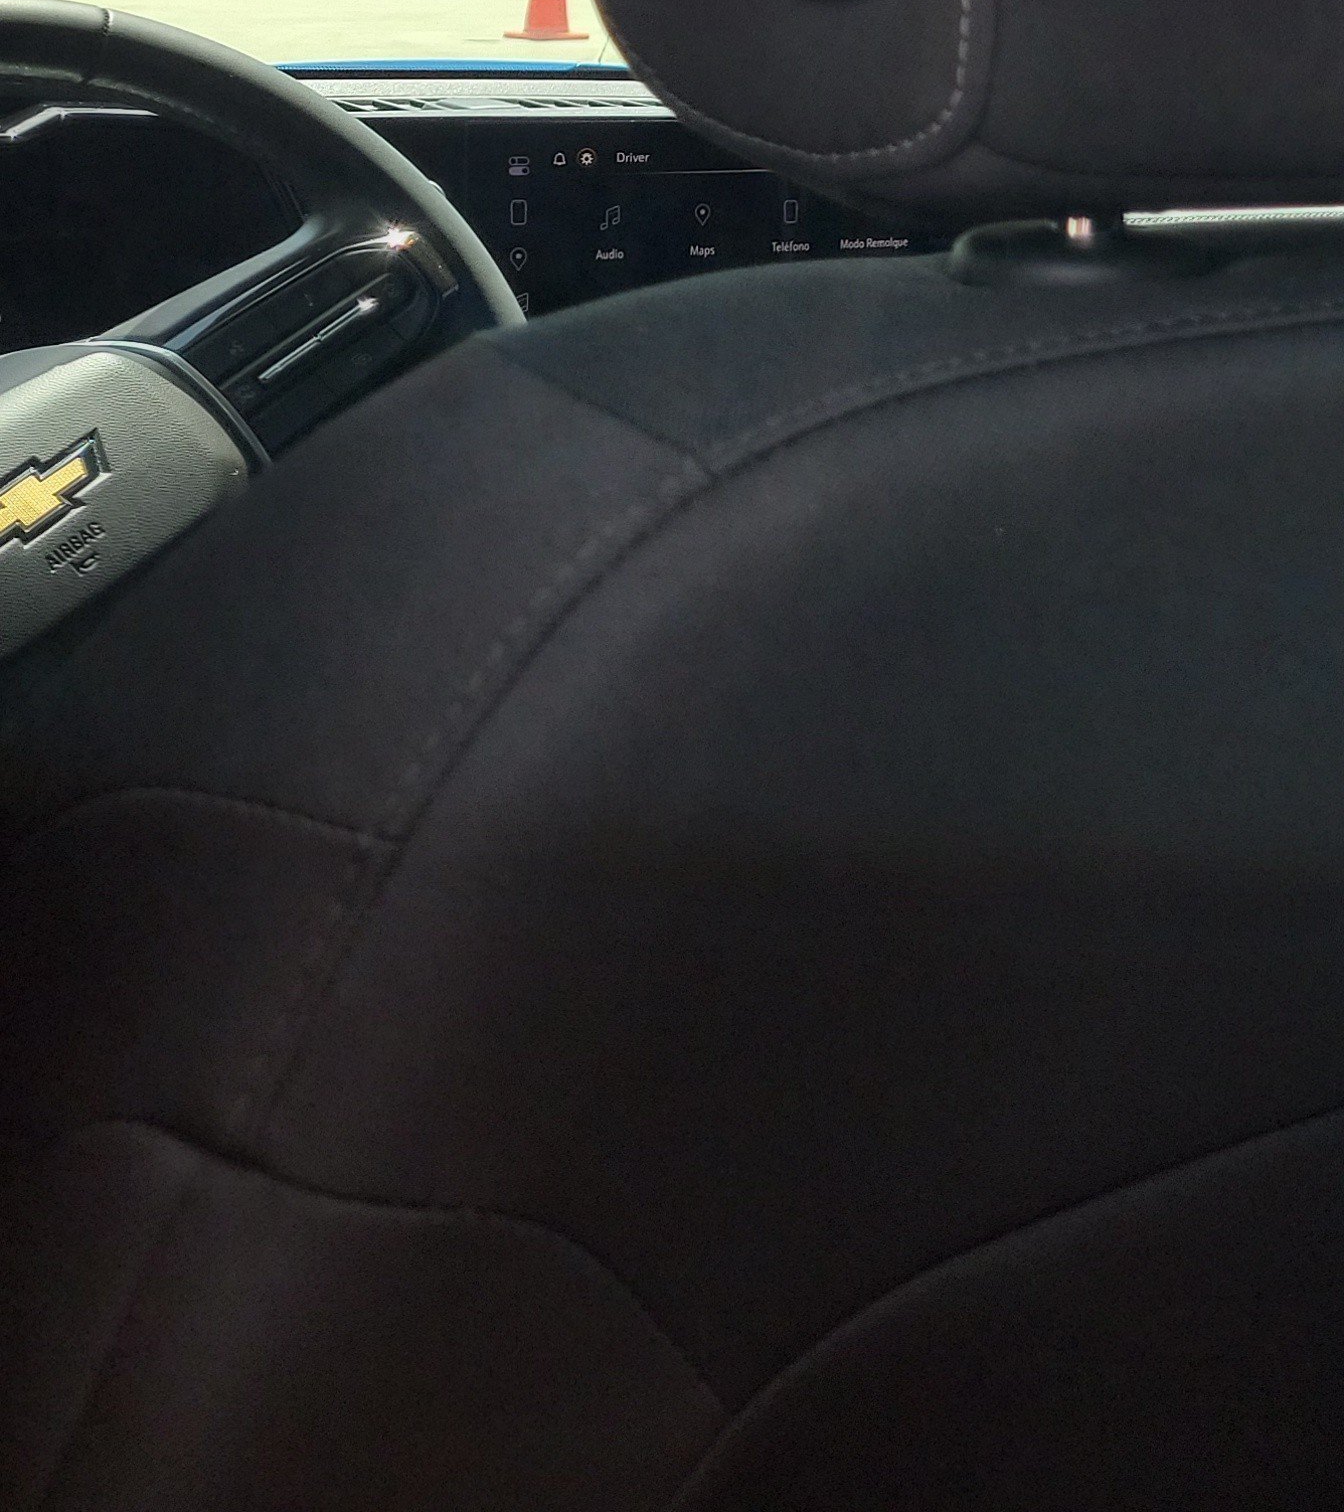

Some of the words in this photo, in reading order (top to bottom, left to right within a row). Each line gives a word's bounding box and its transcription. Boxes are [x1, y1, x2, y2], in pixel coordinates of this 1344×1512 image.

[616, 152, 650, 163] Driver
[595, 248, 625, 260] Audio
[690, 245, 715, 258] Maps
[772, 240, 810, 252] Teléfono
[840, 239, 865, 249] Modo
[866, 237, 909, 249] Remolque
[45, 522, 106, 573] AIRBAG
